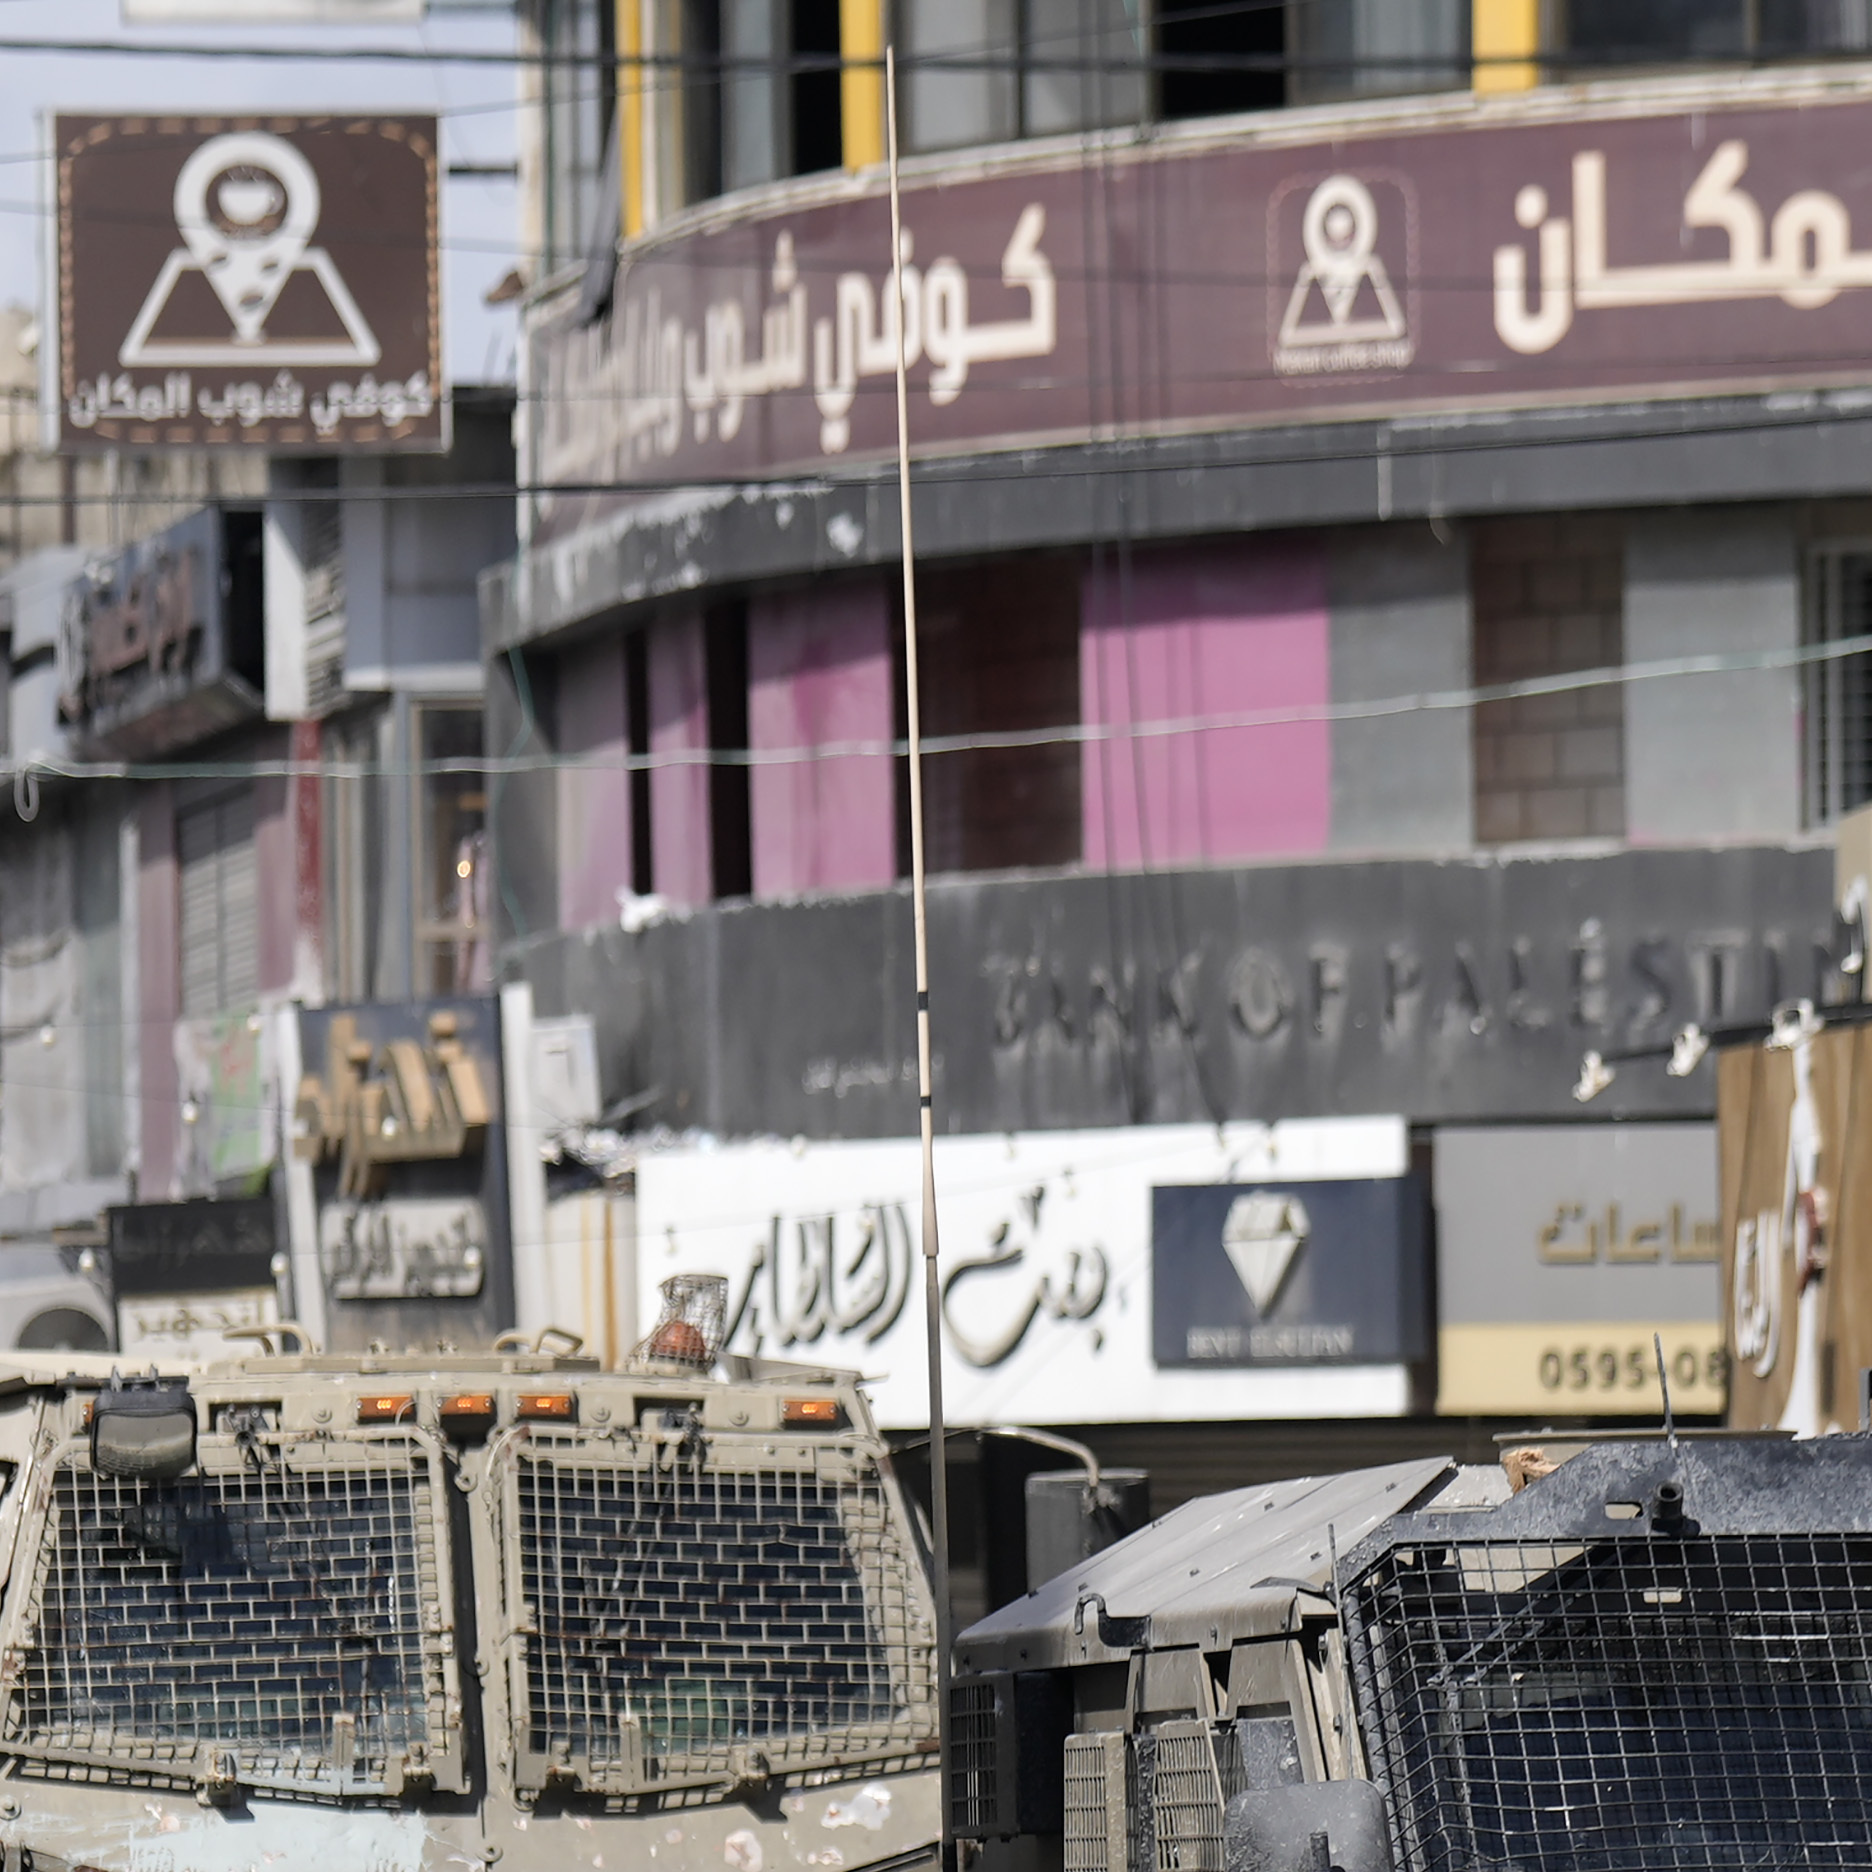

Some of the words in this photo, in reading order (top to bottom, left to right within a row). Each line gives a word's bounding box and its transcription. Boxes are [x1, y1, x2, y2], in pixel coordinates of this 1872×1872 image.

[684, 229, 807, 445] شوب
[814, 202, 1055, 453] كوفي
[69, 370, 193, 429] المكان
[198, 367, 305, 428] شوب
[309, 369, 433, 436] كوفي
[1228, 938, 1351, 1044] OF
[1378, 922, 1860, 1034] PALESTIN
[941, 1184, 1111, 1370] بنت
